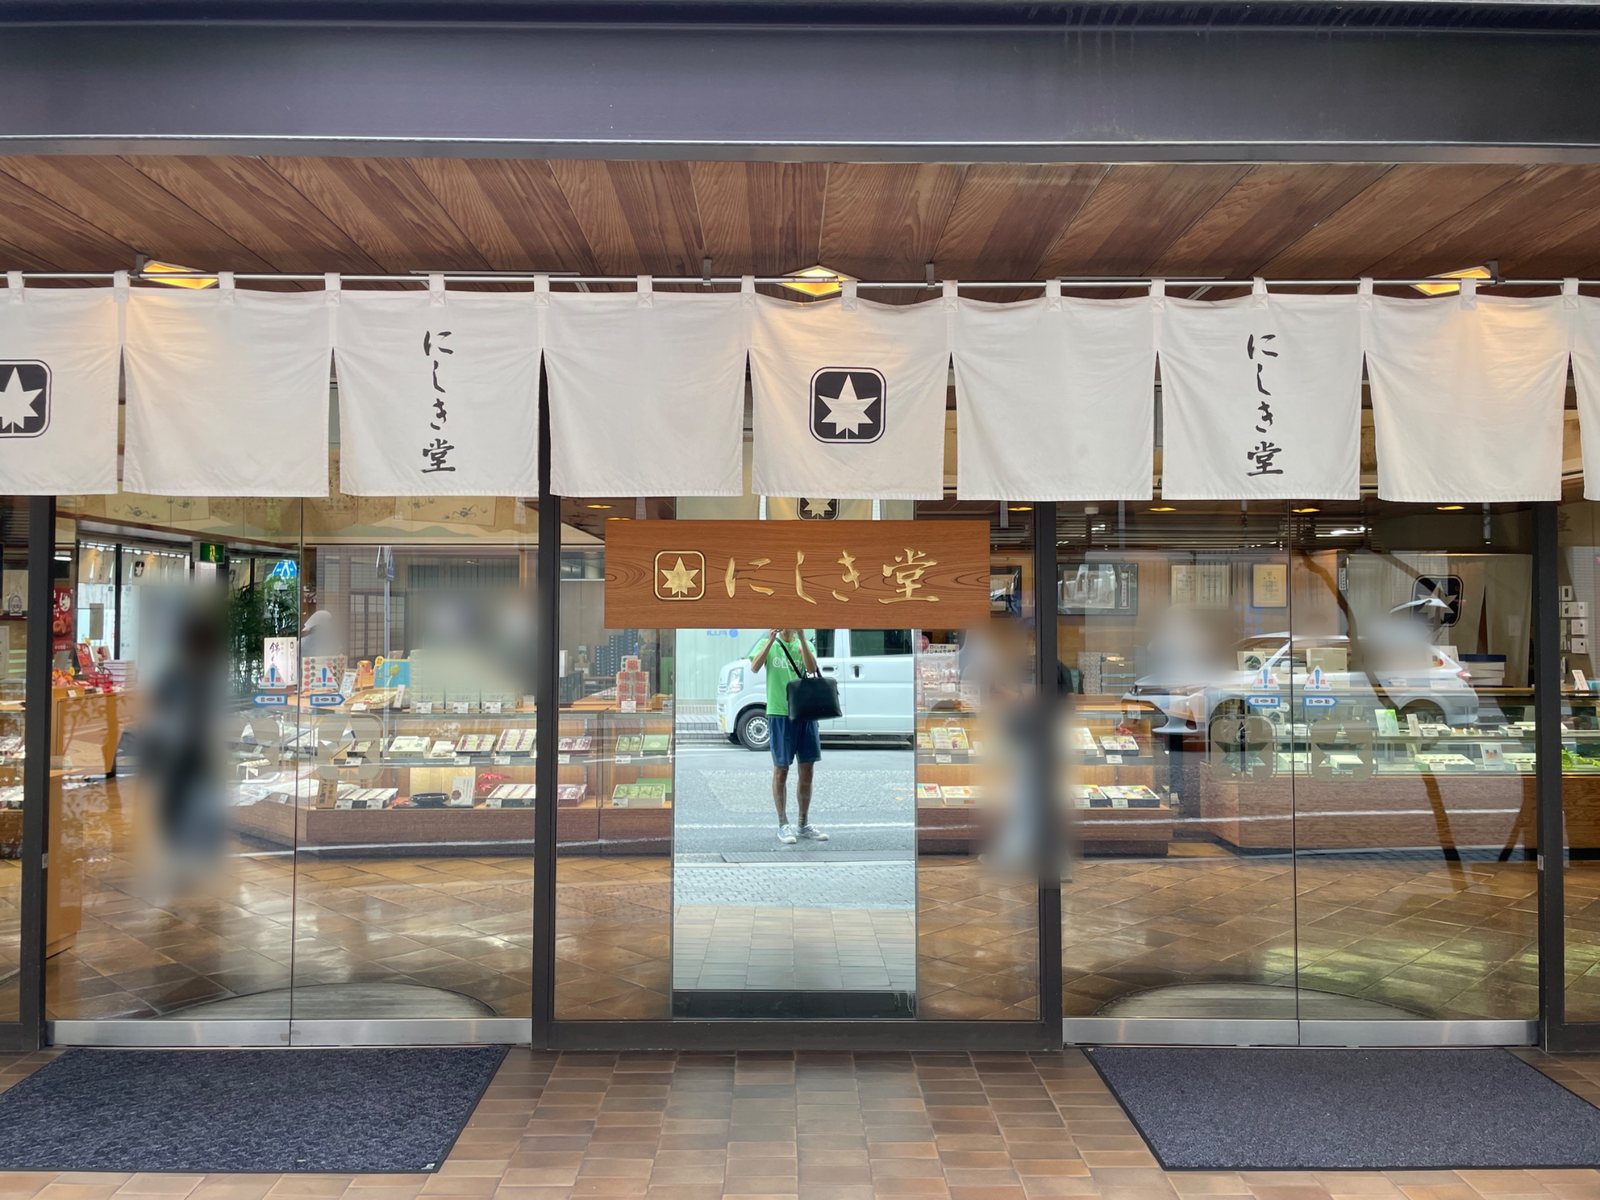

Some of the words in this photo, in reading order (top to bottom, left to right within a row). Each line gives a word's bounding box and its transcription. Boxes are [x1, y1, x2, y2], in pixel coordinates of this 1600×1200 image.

[422, 330, 456, 473] にしき堂
[1247, 334, 1283, 476] にしき堂
[724, 548, 941, 604] にしき堂
